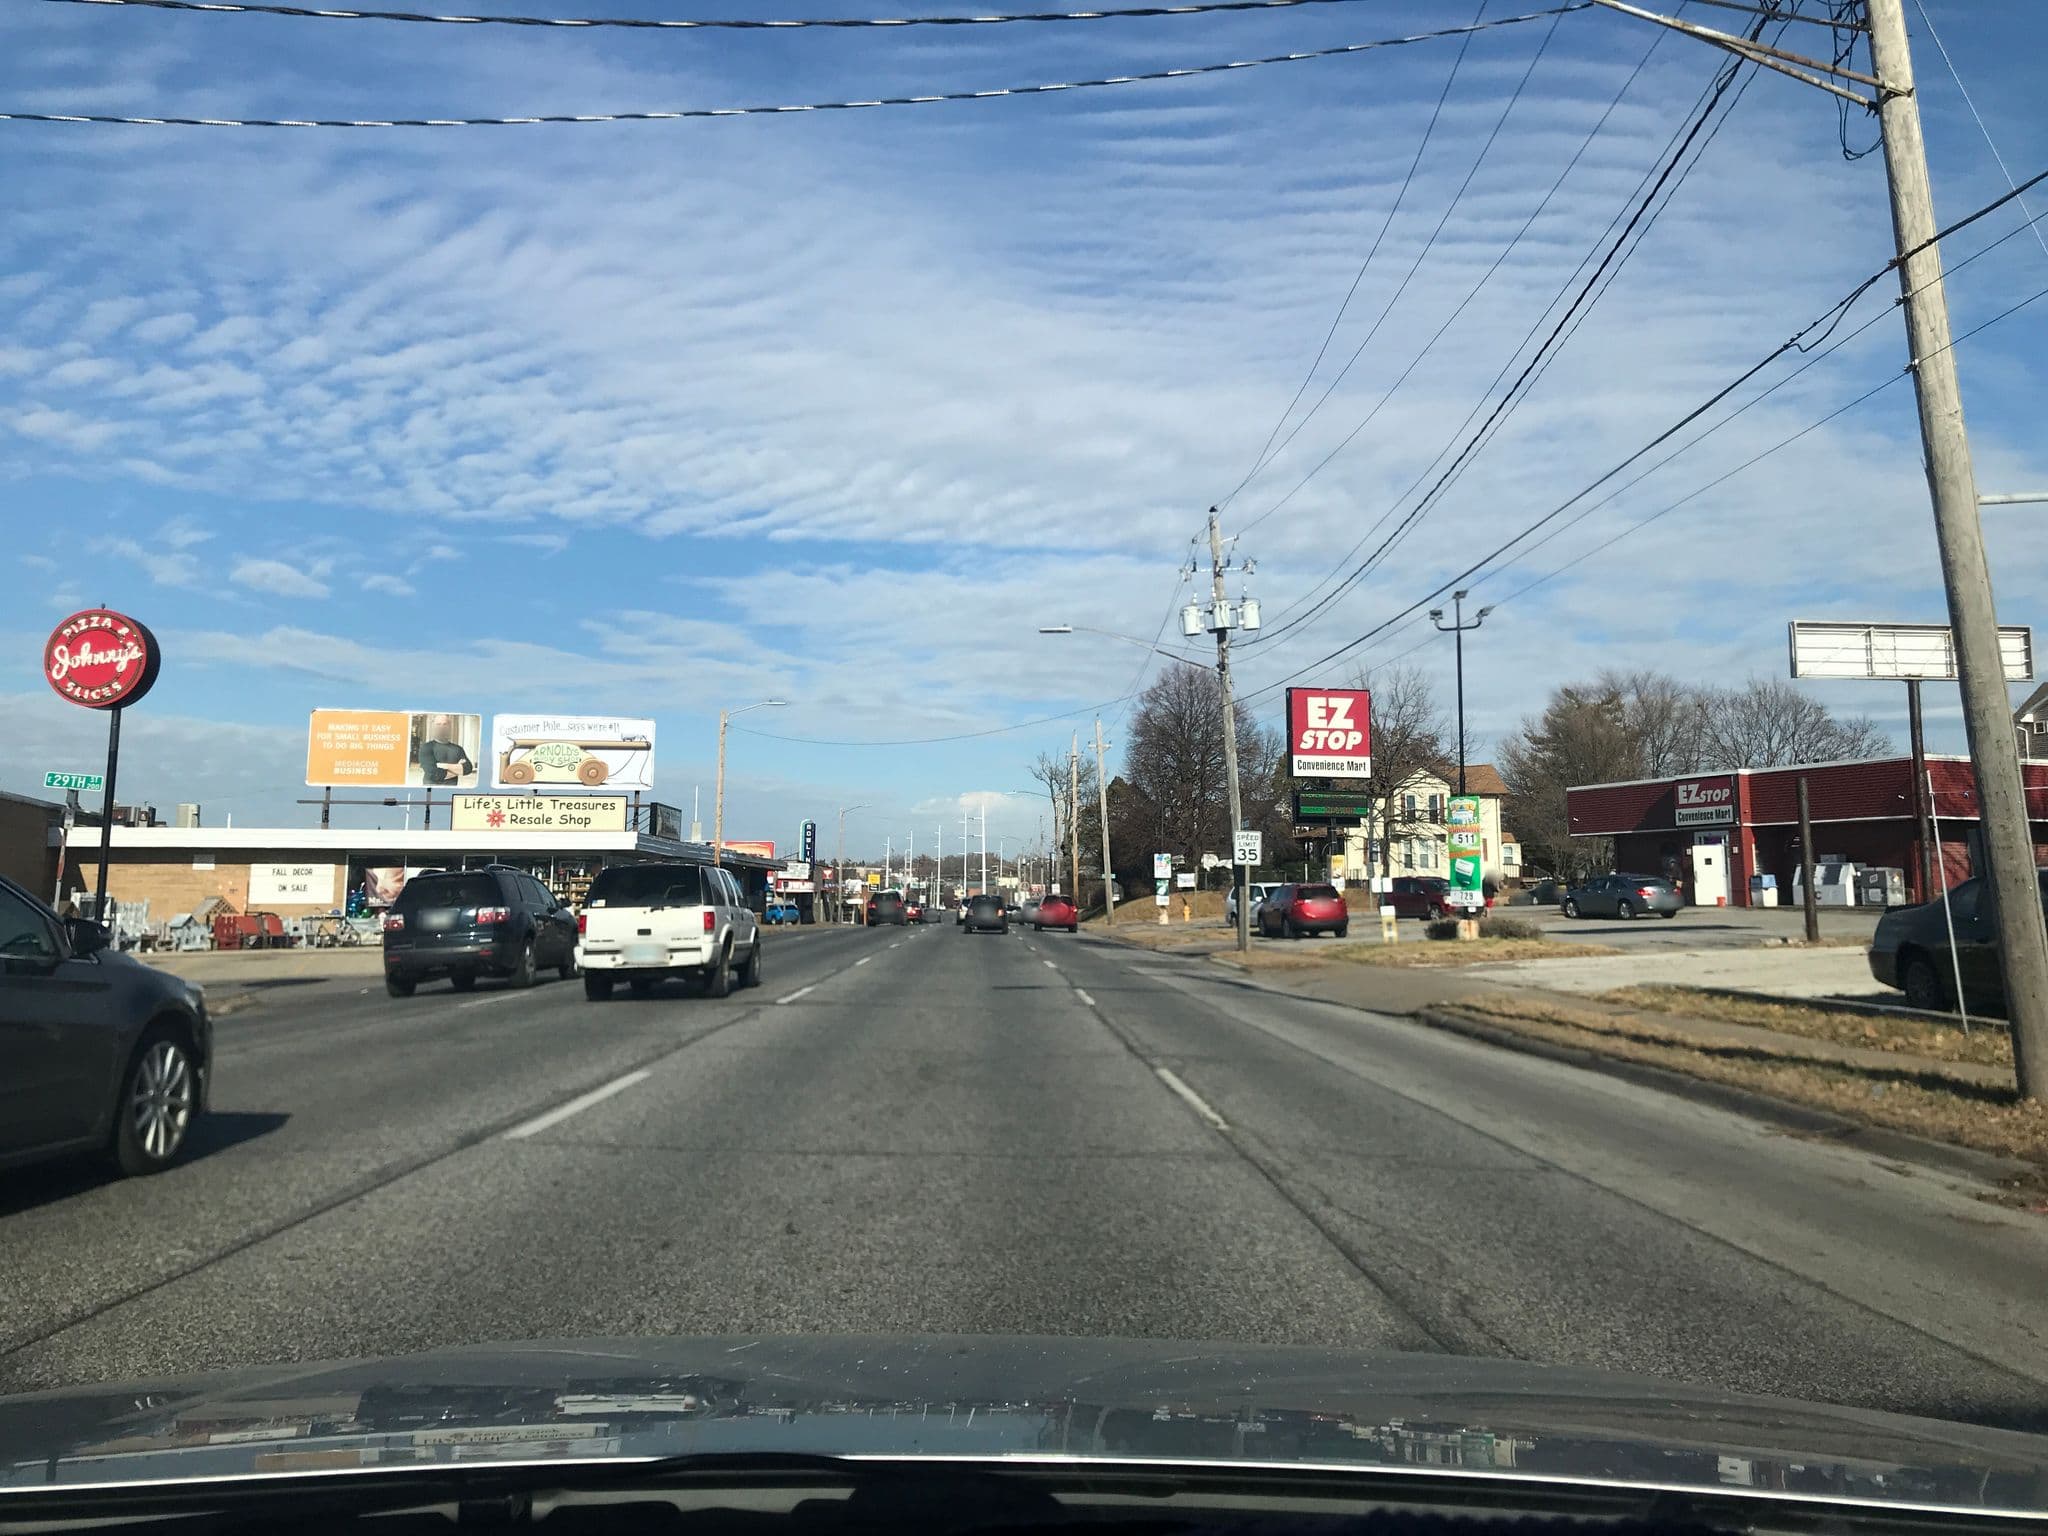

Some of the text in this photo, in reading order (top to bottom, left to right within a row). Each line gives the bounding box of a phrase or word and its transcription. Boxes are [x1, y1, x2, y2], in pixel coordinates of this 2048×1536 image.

[63, 617, 112, 636] PIZZA
[52, 642, 143, 680] Johnny's
[66, 682, 122, 700] SLICES
[1307, 696, 1355, 730] EZ
[372, 724, 391, 732] EASY
[500, 723, 540, 737] Customer
[335, 732, 359, 741] SMALL
[363, 733, 401, 741] BUSINESS
[1300, 729, 1363, 751] STOP
[323, 742, 333, 750] TO
[367, 742, 394, 751] THINGS
[333, 767, 379, 776] BUSINESS
[1297, 759, 1367, 772] Convenience Mart
[53, 774, 86, 788] 29TH
[1678, 784, 1730, 804] EZ STOP
[464, 798, 616, 811] Life's Little Treasures
[510, 813, 592, 828] Resale Shop
[1678, 809, 1731, 822] Convenience Mart
[1458, 834, 1475, 844] 511
[1238, 848, 1258, 861] 35
[272, 868, 313, 876] FALL DECOR
[278, 884, 308, 893] ON SALE
